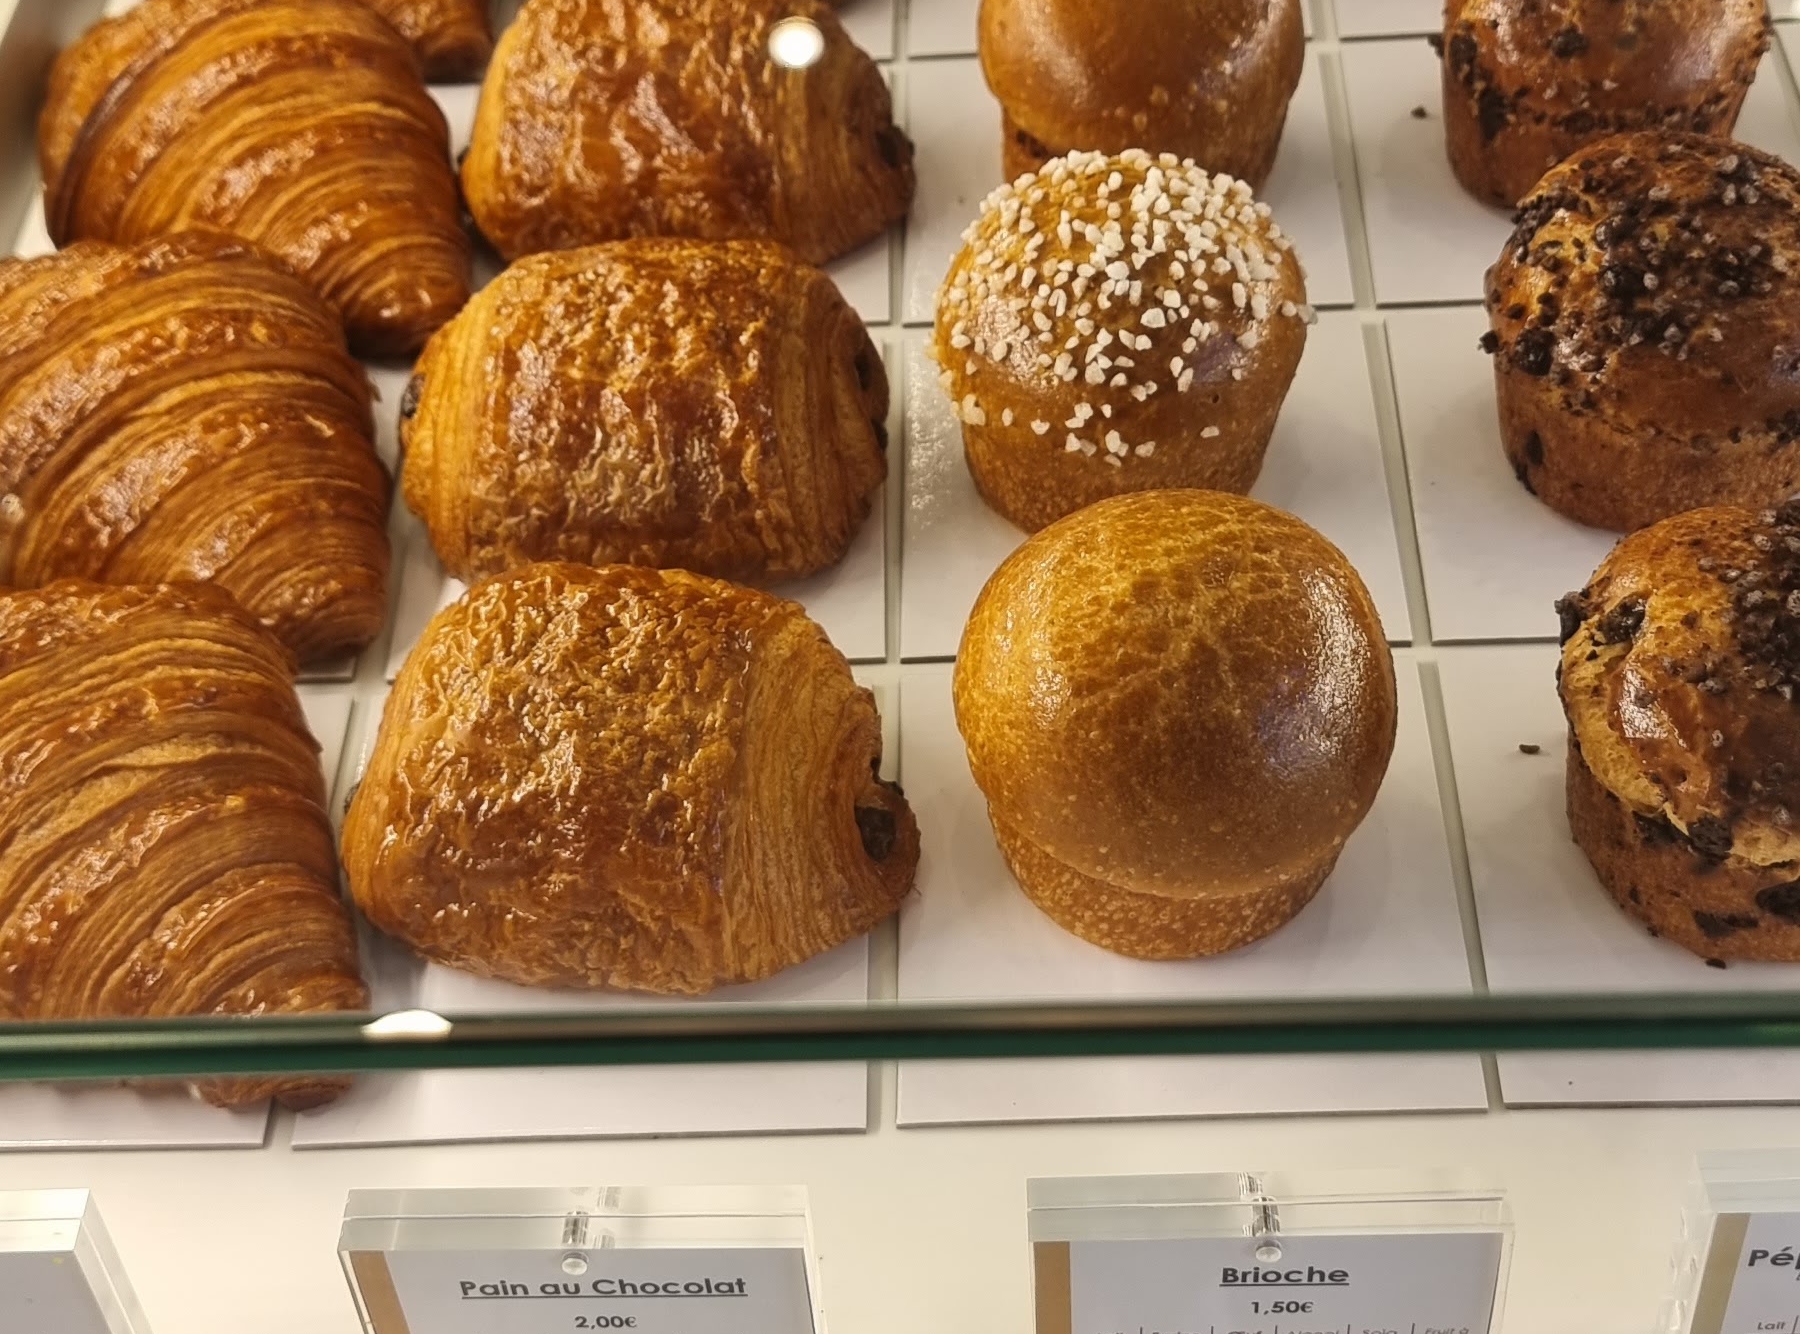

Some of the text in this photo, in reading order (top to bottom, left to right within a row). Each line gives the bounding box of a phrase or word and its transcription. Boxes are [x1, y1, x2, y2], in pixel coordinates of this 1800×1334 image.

[1748, 1246, 1800, 1269] Pé
[1221, 1266, 1349, 1284] Brioche
[459, 1278, 747, 1297] Pain au Chocolat
[1251, 1300, 1314, 1316] 1,50€
[574, 1315, 637, 1330] 2,00€
[1757, 1321, 1786, 1331] Lait
